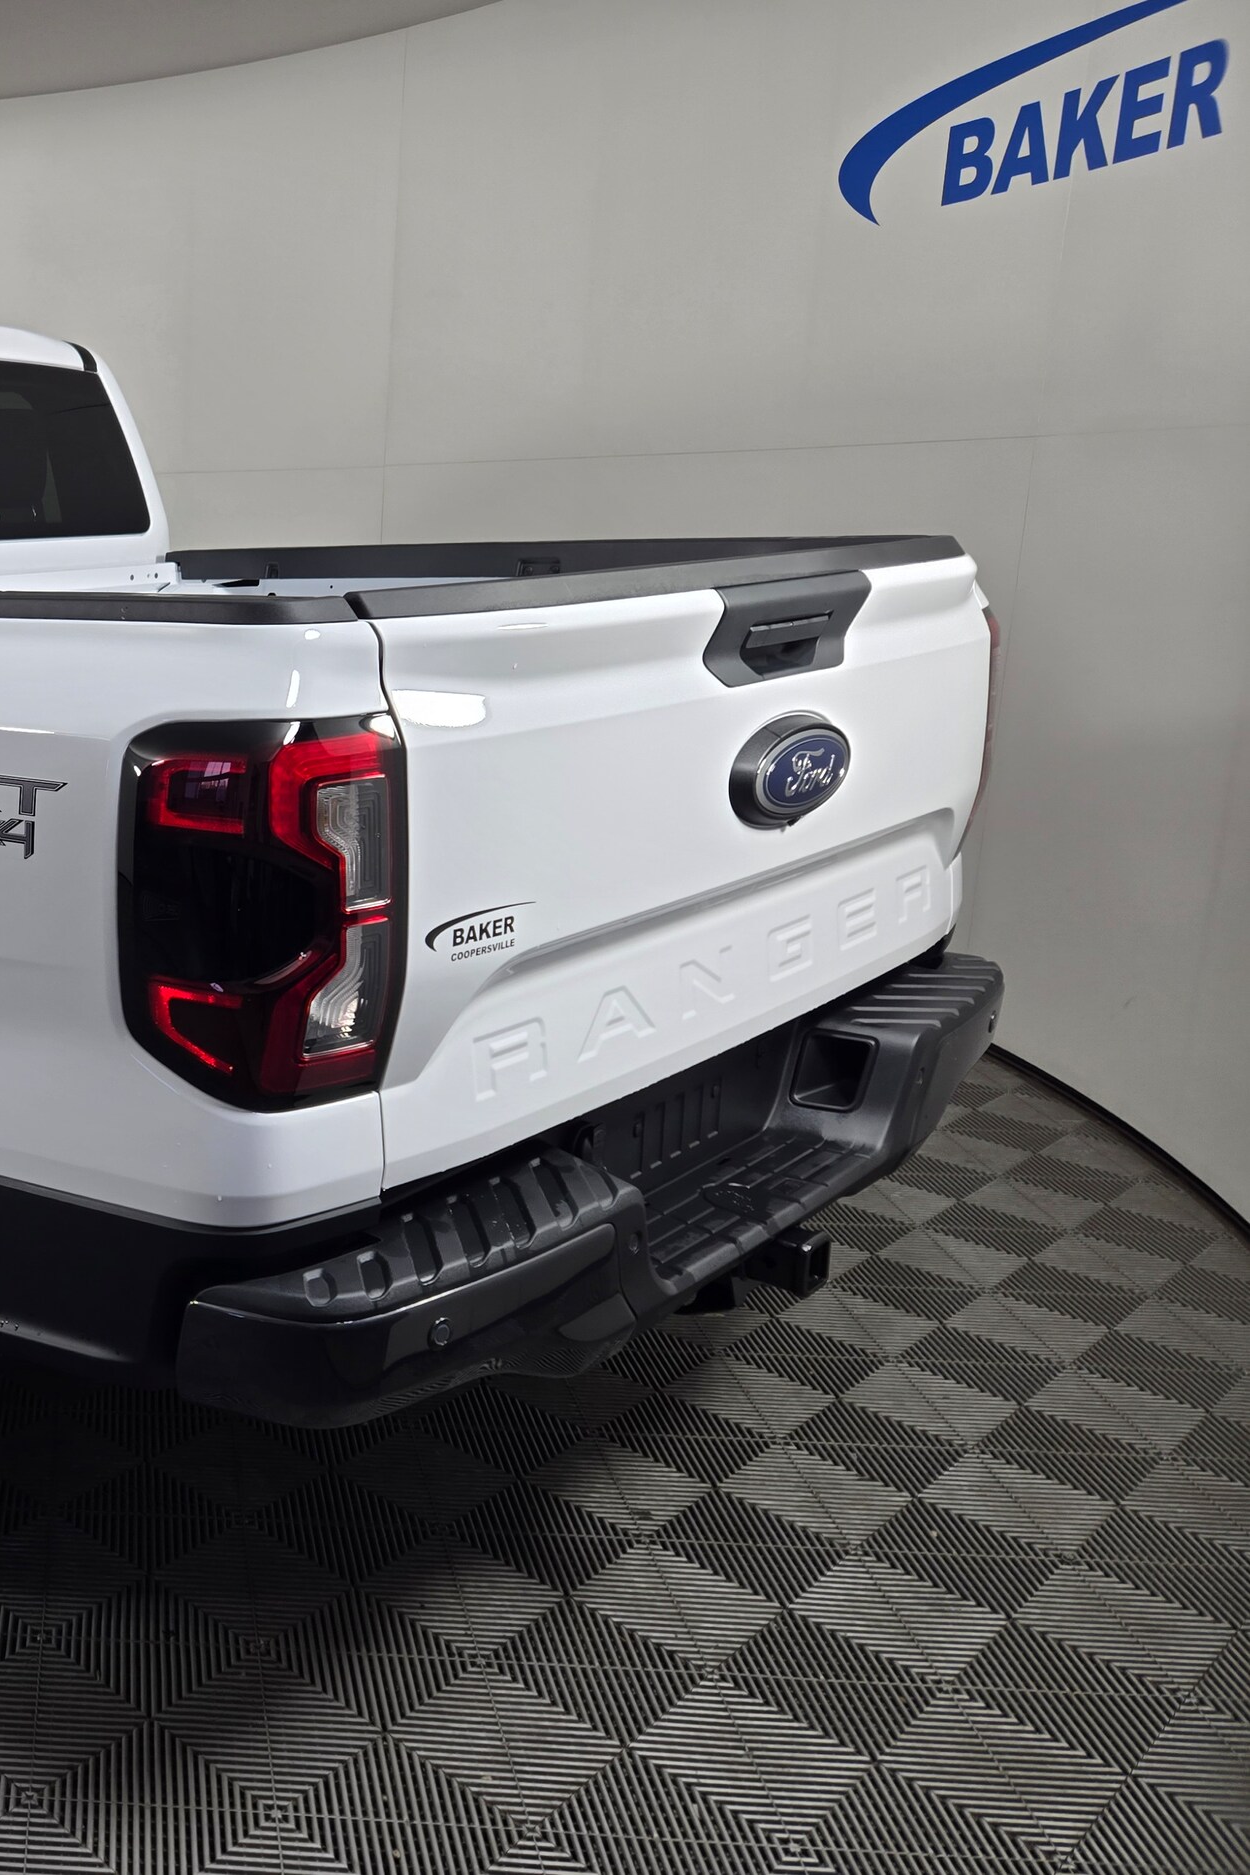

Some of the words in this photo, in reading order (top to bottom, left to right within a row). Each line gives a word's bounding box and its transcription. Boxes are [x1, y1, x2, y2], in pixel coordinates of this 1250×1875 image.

[941, 38, 1230, 206] BAKER
[785, 747, 836, 798] Ford
[450, 938, 515, 962] COOPERSVILLE
[452, 915, 515, 947] BAKER
[472, 864, 932, 1102] RANGER
